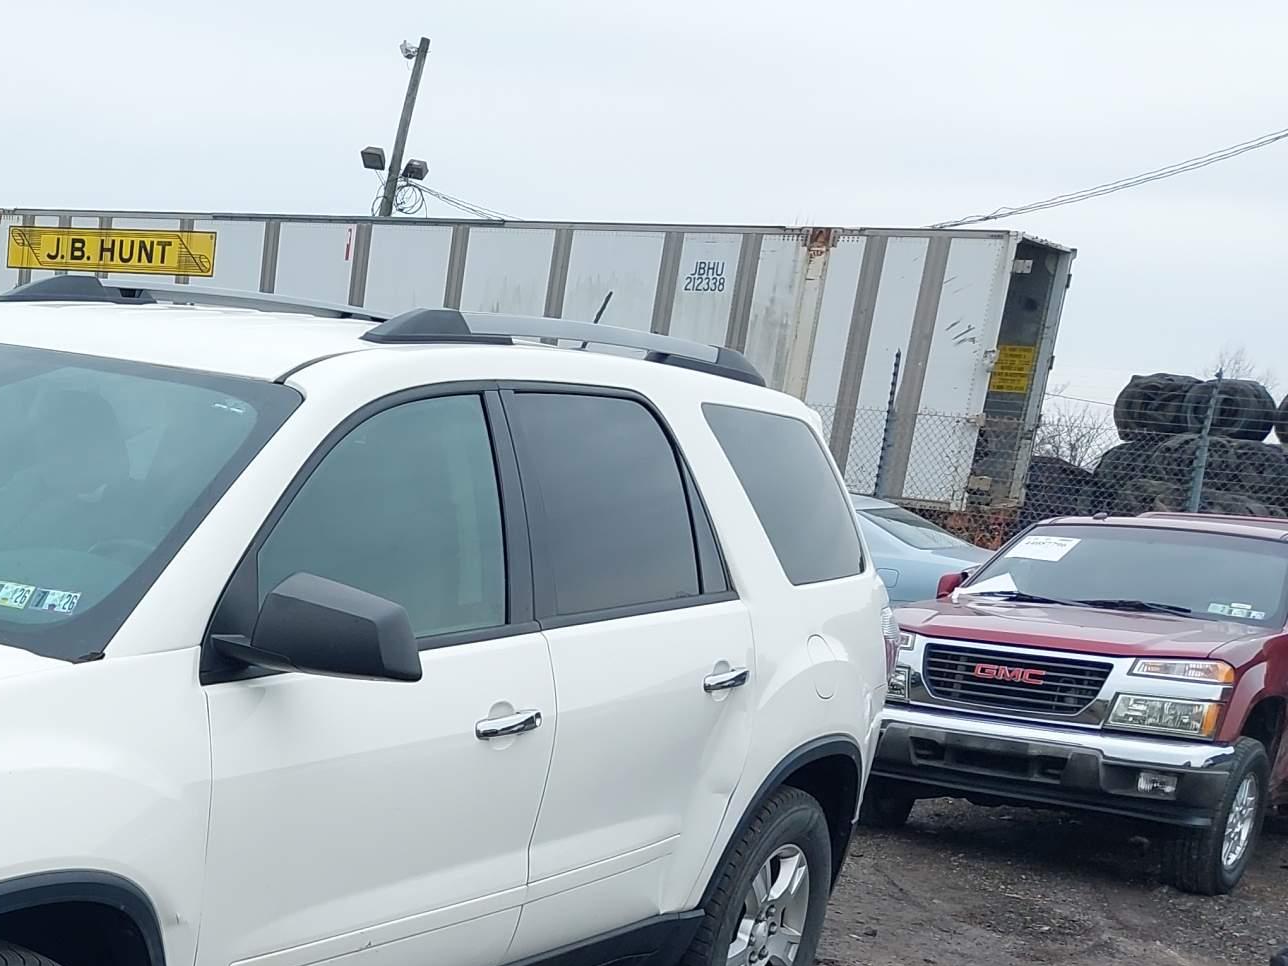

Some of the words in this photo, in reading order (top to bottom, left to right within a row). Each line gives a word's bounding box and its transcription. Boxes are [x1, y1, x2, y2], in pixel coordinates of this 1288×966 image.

[46, 237, 91, 262] J.B.
[99, 238, 173, 265] HUNT
[690, 260, 726, 277] JBHU
[683, 276, 726, 292] 212338
[973, 663, 1047, 686] GMC
